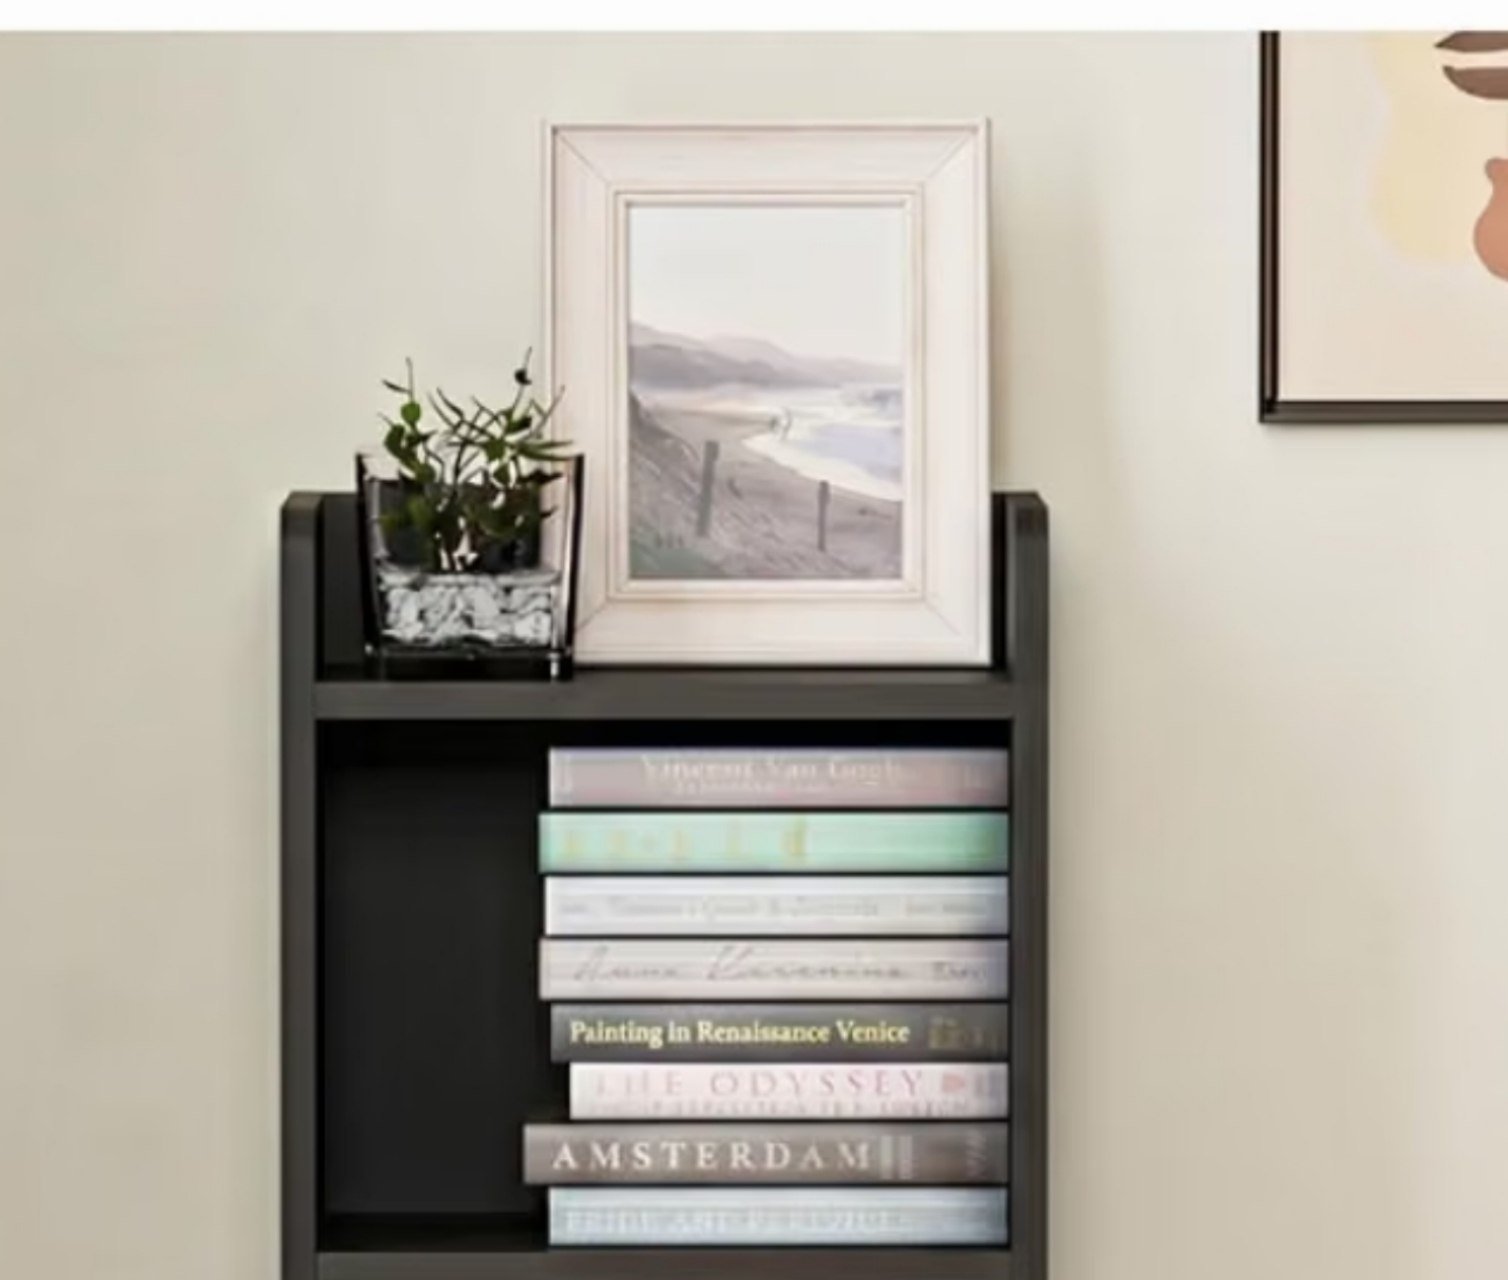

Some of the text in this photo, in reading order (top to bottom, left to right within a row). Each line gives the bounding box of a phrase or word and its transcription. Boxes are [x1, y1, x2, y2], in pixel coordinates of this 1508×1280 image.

[569, 1021, 664, 1049] Painting
[667, 1021, 691, 1044] in
[696, 1021, 829, 1044] Renaissance
[836, 1021, 911, 1044] Venice
[709, 1070, 924, 1098] ODYSSEY
[552, 1140, 871, 1172] AMSTERDAM
